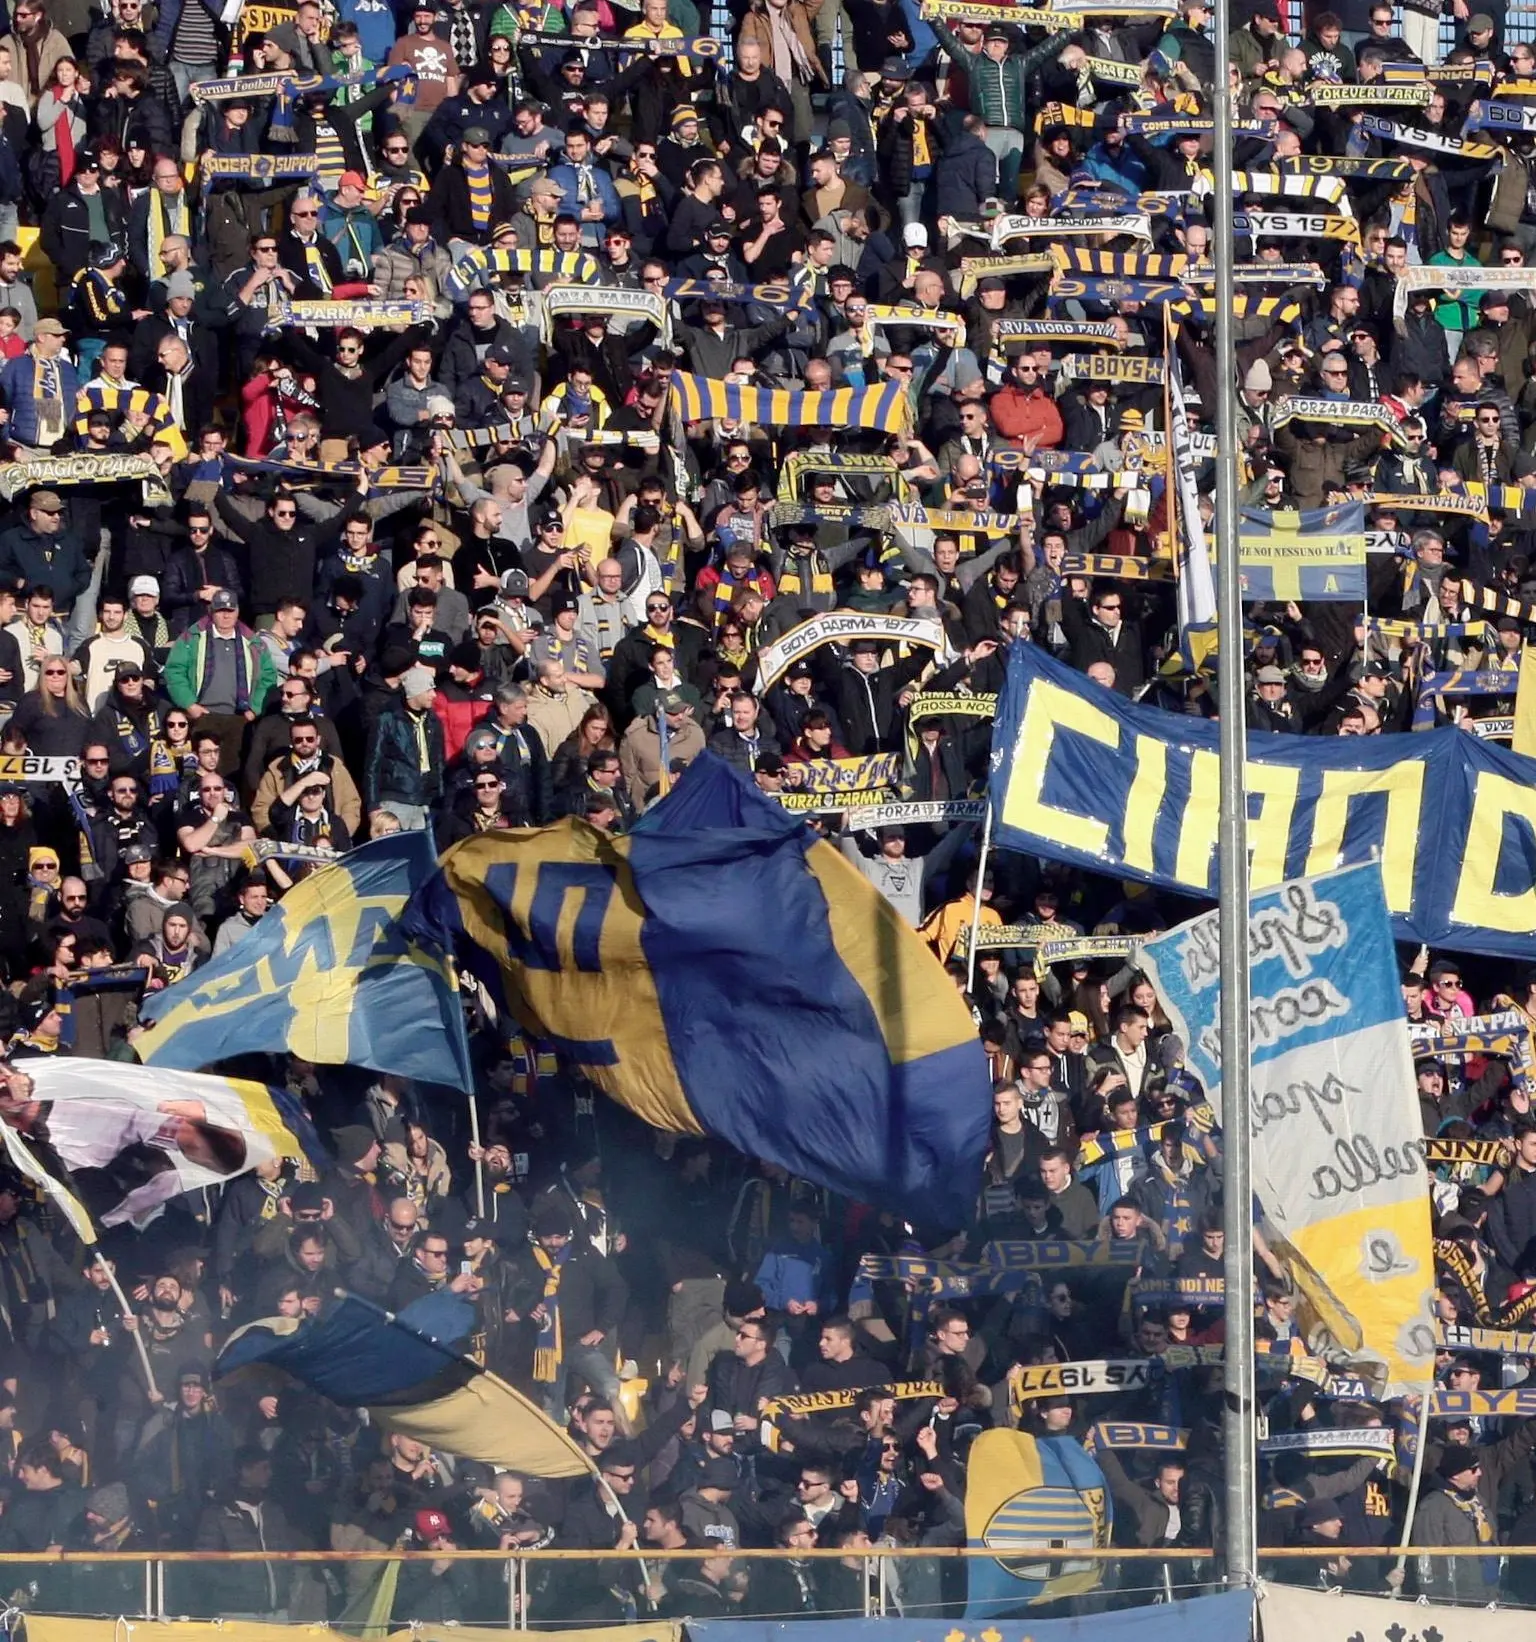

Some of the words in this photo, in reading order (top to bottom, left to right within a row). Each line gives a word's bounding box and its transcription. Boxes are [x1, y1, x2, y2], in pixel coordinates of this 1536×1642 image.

[233, 77, 278, 94] Football
[1233, 215, 1288, 231] OYS
[1295, 214, 1357, 235] 1977
[301, 305, 364, 321] PARMA
[1092, 356, 1144, 377] BOYS
[27, 458, 98, 478] MAGICO
[1255, 547, 1272, 556] NOI
[1274, 547, 1322, 557] NESSUNO
[781, 627, 818, 656] BOYS
[820, 619, 877, 634] PARMA
[781, 792, 822, 808] FORZA
[833, 790, 884, 806] PARMA
[1002, 679, 1427, 914] CIAO
[876, 803, 920, 818] FORZA
[1004, 1240, 1144, 1267] BOYS
[1022, 1368, 1096, 1392] 1977
